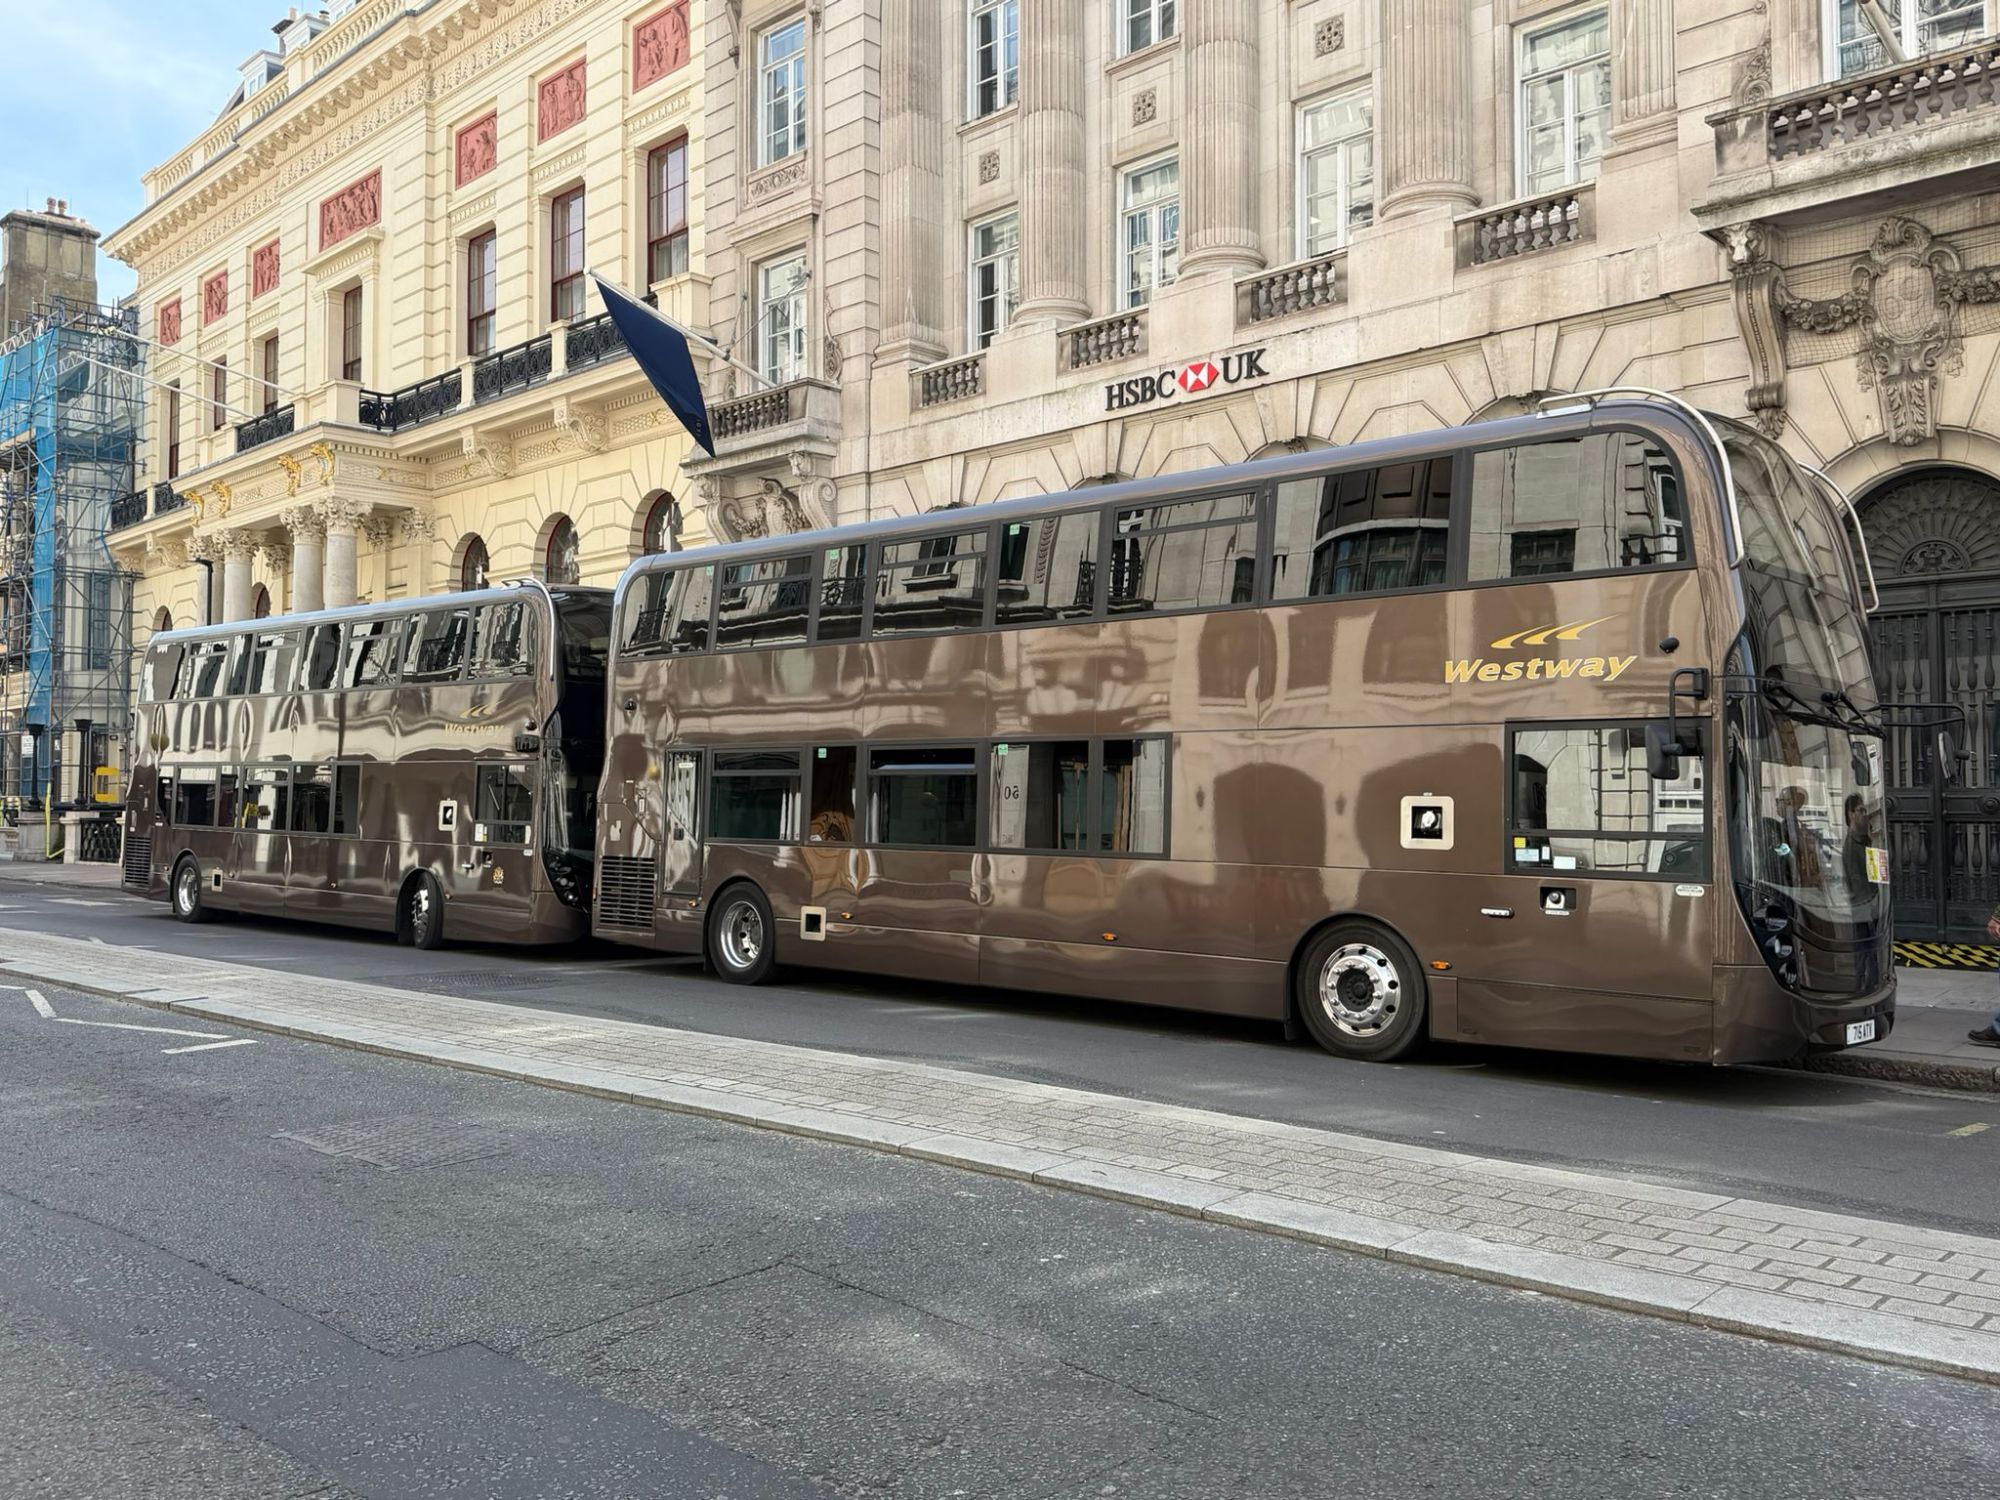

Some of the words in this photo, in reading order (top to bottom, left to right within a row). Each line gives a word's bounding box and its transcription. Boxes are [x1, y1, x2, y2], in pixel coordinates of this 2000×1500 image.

[1105, 370, 1176, 411] HSBC
[1221, 348, 1269, 383] UK
[1445, 655, 1639, 683] Westway
[445, 723, 505, 737] Westway
